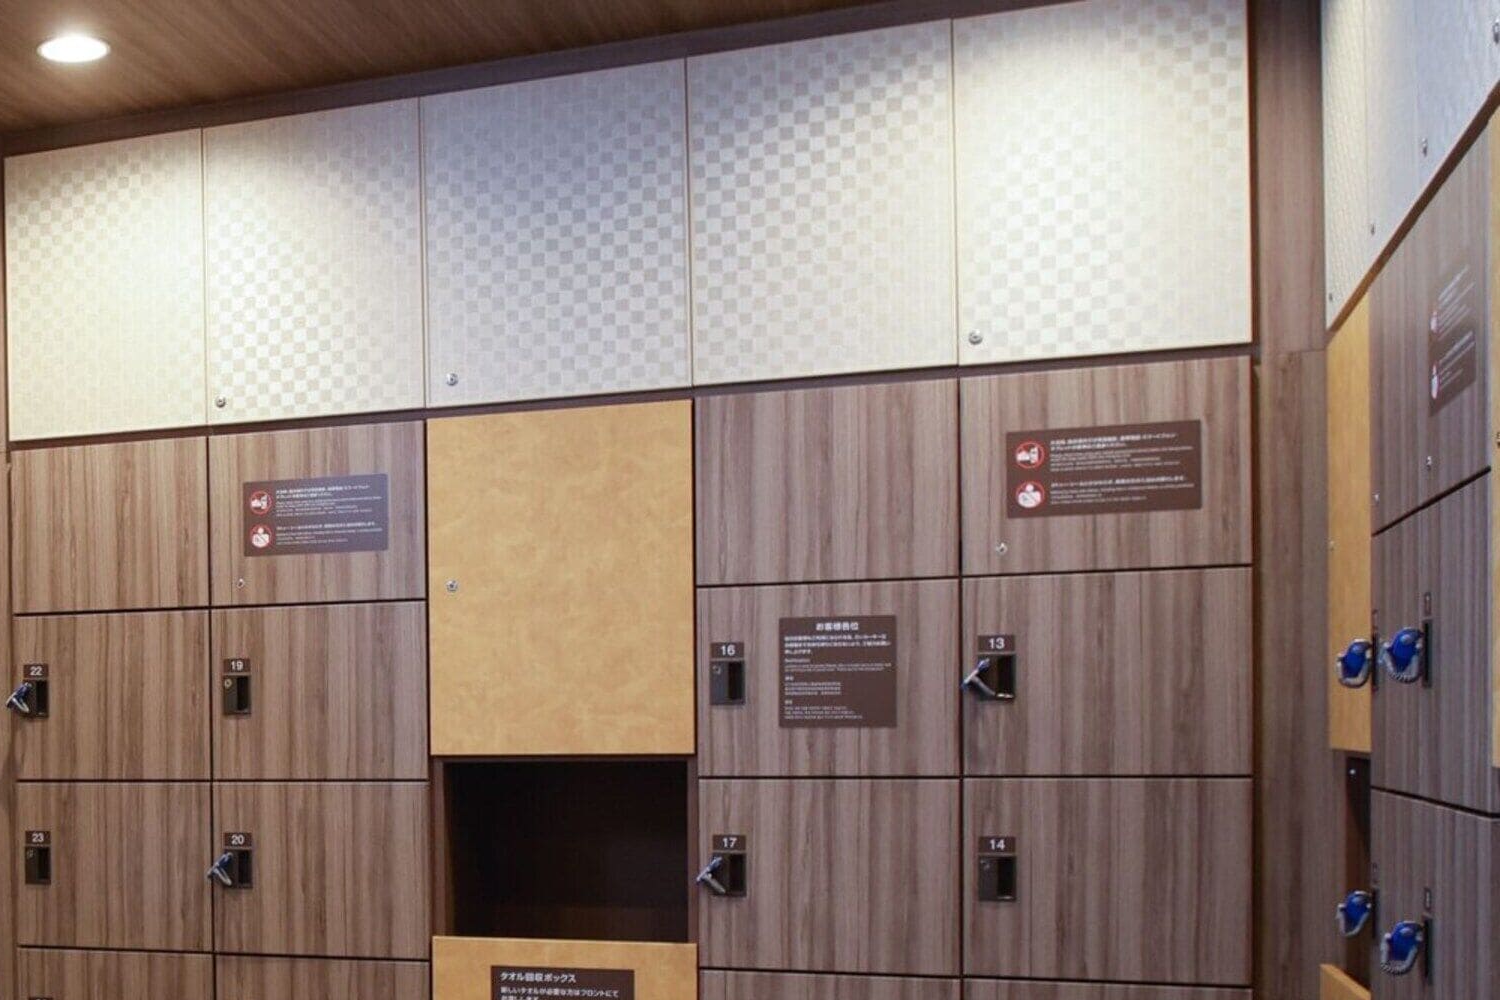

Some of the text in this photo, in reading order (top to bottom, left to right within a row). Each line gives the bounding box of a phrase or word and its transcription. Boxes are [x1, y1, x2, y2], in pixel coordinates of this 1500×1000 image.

[989, 637, 1005, 650] 13
[720, 644, 736, 657] 16
[29, 665, 43, 676] 22
[231, 660, 244, 671] 19
[31, 832, 45, 843] 23
[231, 834, 245, 845] 20
[722, 836, 738, 848] 17
[990, 839, 1006, 850] 14
[500, 972, 577, 983] タオル回収ボックス
